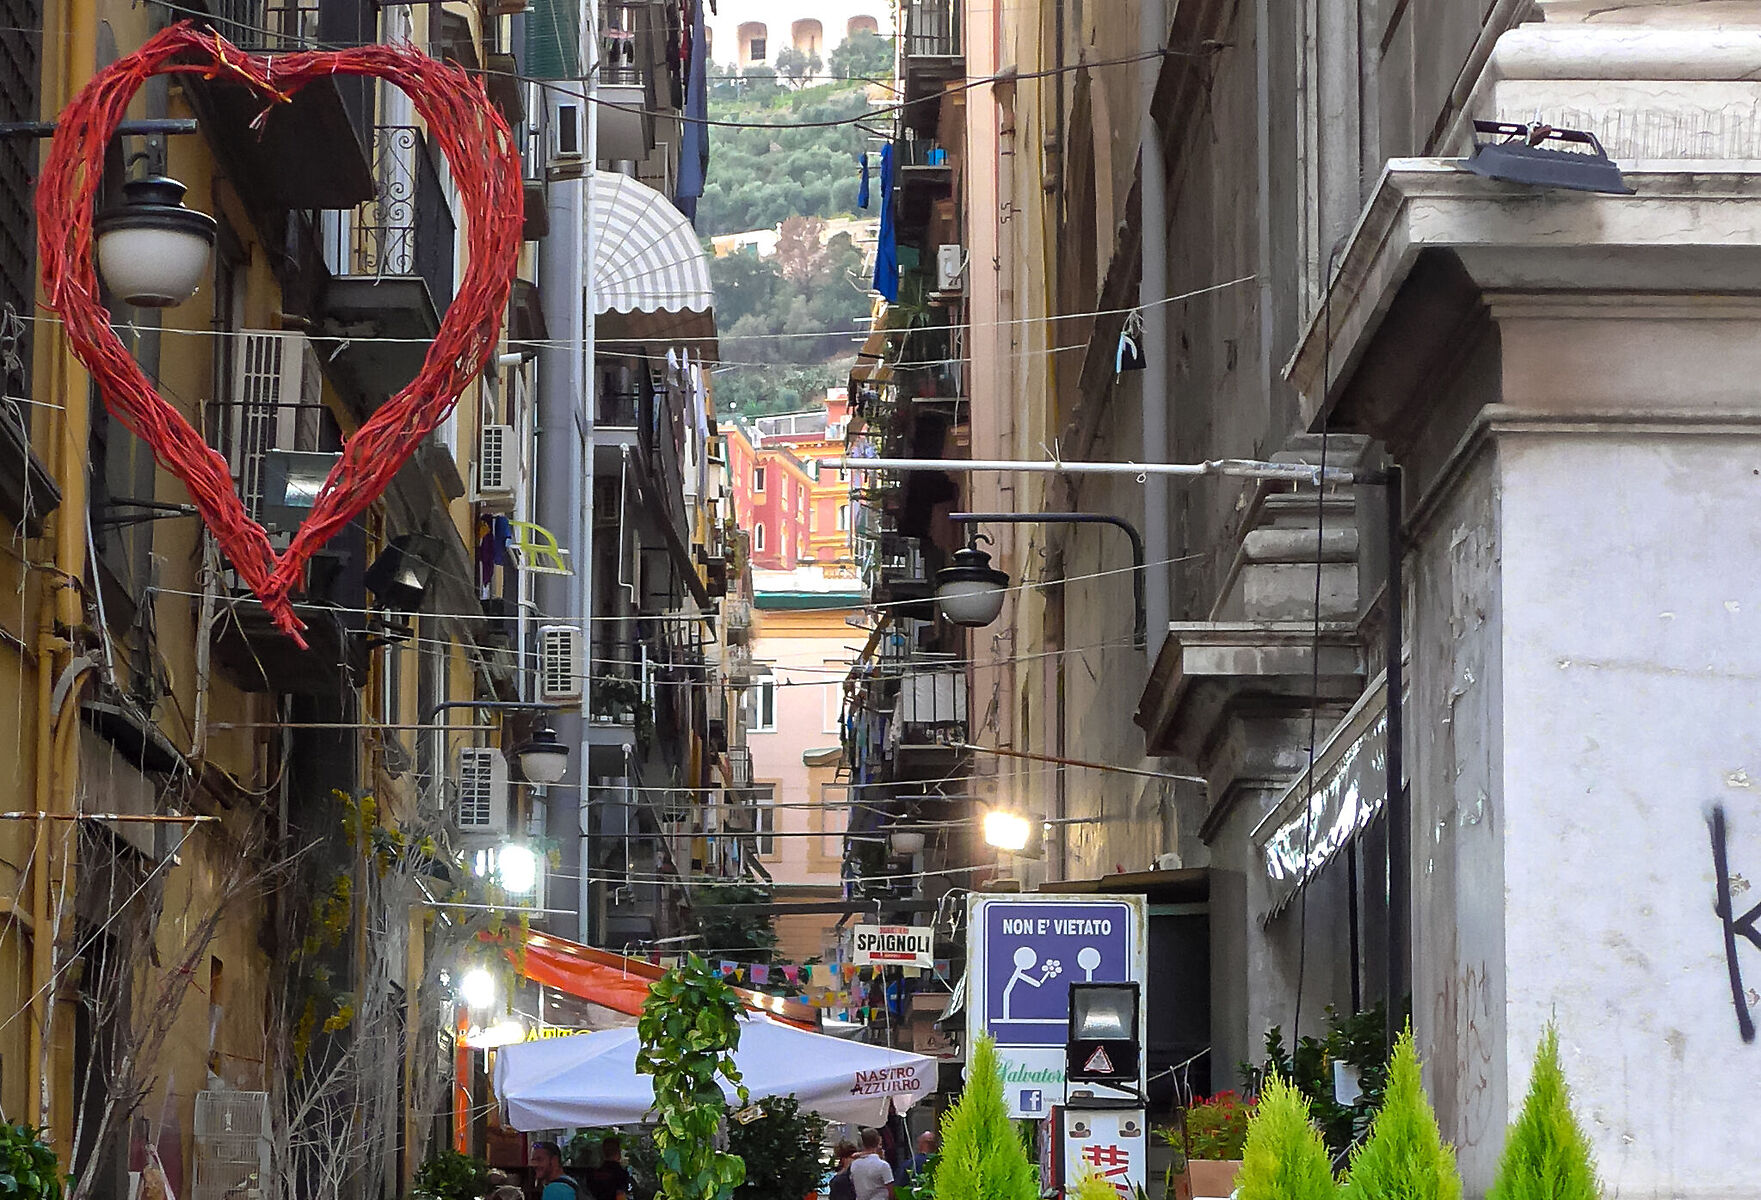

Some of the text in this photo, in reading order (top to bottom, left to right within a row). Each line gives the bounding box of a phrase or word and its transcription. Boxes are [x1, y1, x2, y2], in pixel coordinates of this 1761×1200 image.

[1003, 919, 1111, 936] NON E' VIETATO
[857, 933, 930, 953] SPAGNOLI
[855, 1066, 915, 1083] NASTRO
[850, 1078, 920, 1095] AZZURRO
